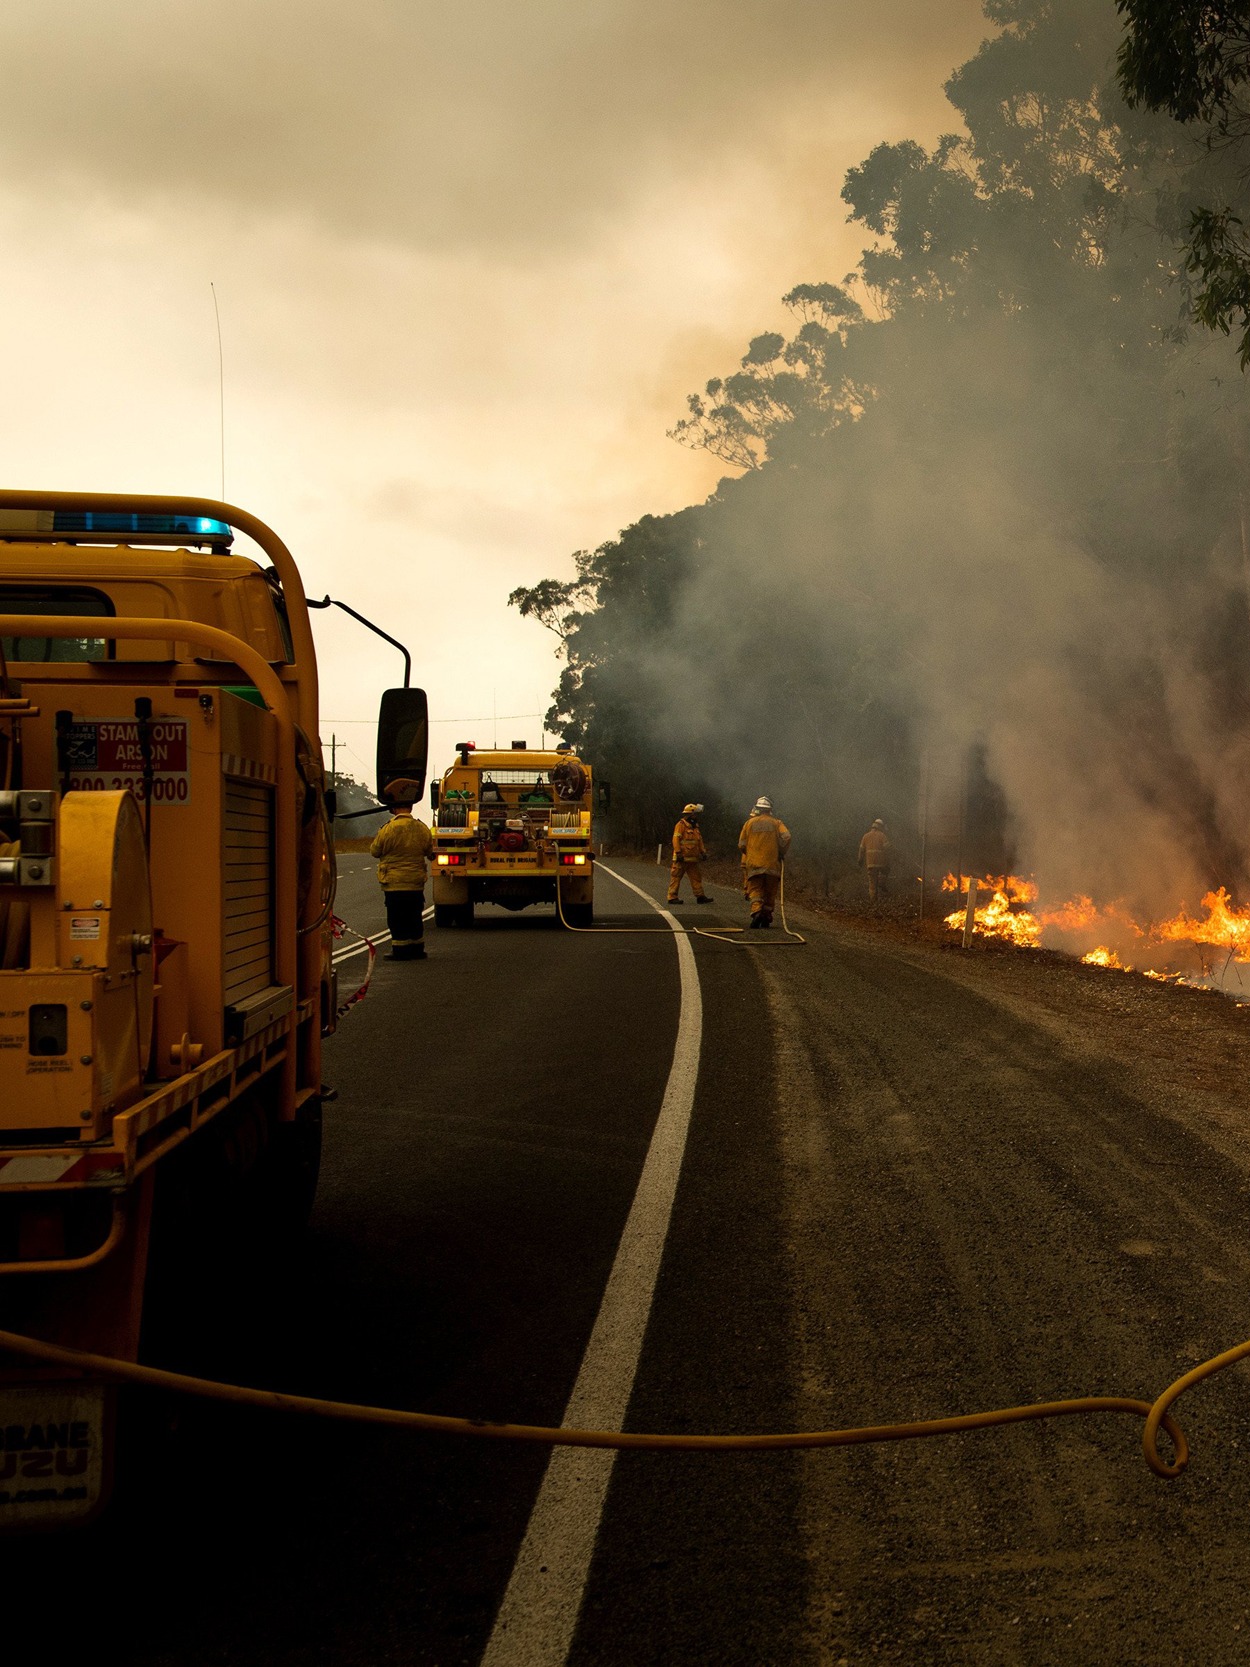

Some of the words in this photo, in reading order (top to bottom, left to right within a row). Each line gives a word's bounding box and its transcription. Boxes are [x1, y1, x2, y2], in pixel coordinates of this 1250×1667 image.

[99, 725, 143, 741] STAM
[153, 725, 184, 741] OUT
[153, 777, 188, 801] 000
[0, 1422, 90, 1451] BANE
